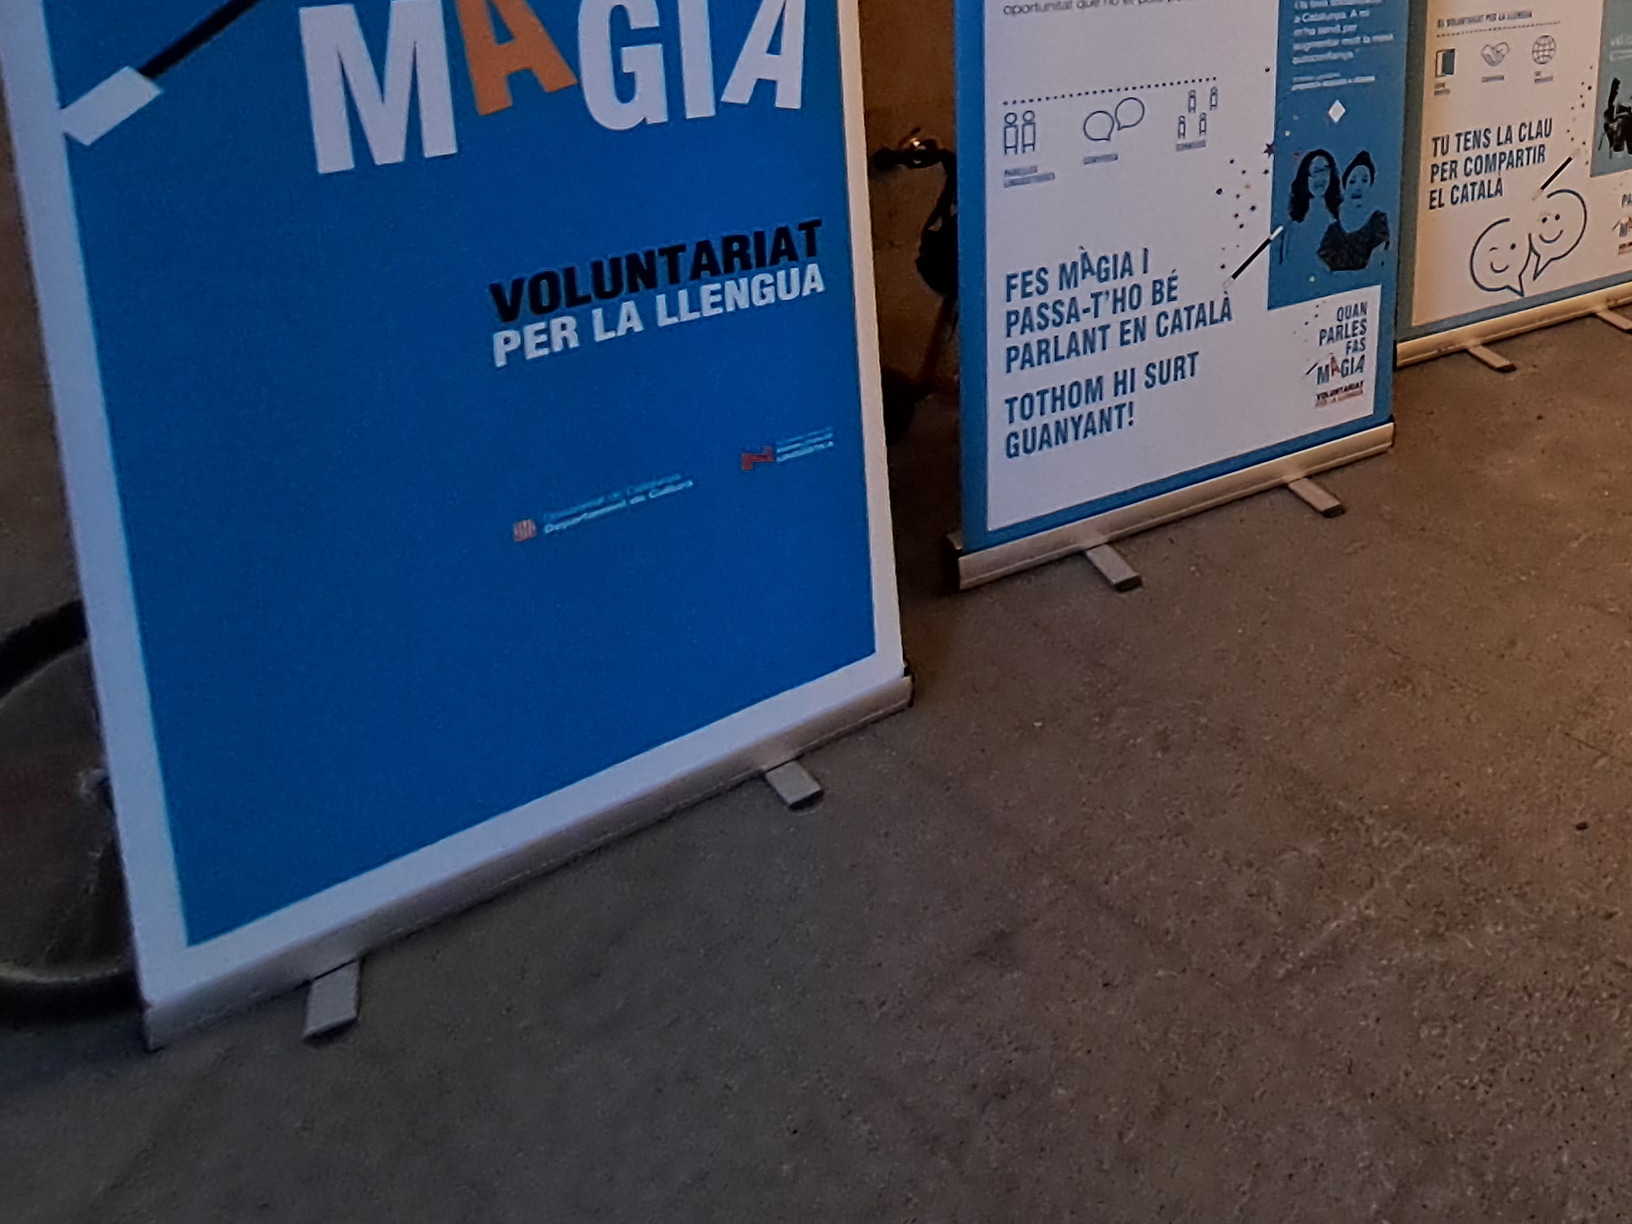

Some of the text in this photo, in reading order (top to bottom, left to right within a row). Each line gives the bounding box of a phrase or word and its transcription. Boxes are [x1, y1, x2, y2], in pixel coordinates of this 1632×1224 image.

[1077, 0, 1100, 9] que
[1432, 118, 1552, 157] TU TENS LA CLAU
[1430, 144, 1546, 183] PER COMPARTIR
[1429, 188, 1445, 210] EL
[489, 218, 822, 323] VOLUNTARIAT
[1006, 246, 1148, 302] FES MÀGIA I
[492, 264, 825, 367] PER LA LLENGUA
[1006, 269, 1179, 338] PASSA-T'HO BÉ
[1337, 302, 1367, 322] QUAN
[1006, 291, 1233, 373] PARLANT EN CATALÀ
[1319, 318, 1367, 346] PARLES
[1346, 337, 1366, 355] FAS
[1005, 352, 1199, 424] TOTHOM HI SURT
[1317, 353, 1365, 385] MÀGIA
[1006, 401, 1134, 459] GUANYANT!
